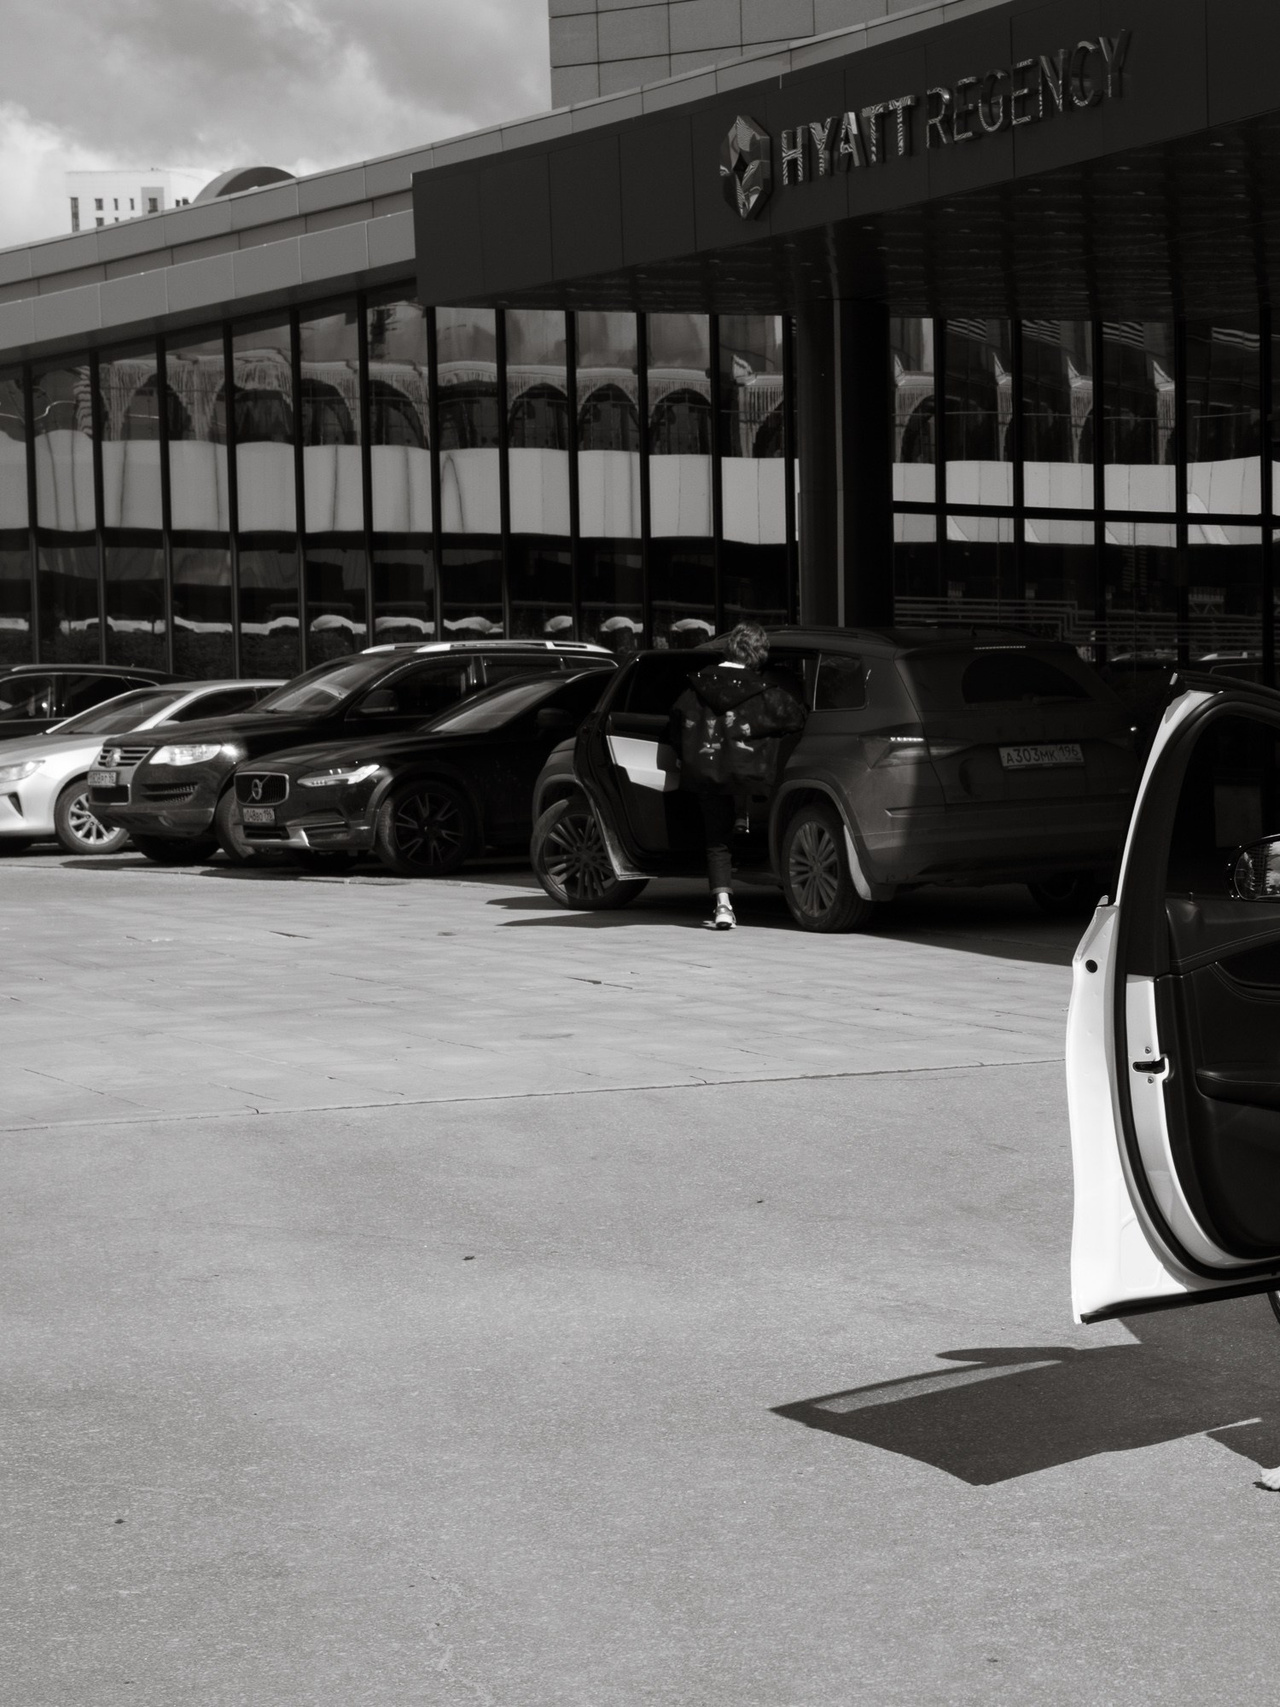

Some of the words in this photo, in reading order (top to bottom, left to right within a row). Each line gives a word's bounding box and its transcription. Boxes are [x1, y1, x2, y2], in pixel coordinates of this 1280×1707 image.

[780, 95, 917, 185] HYATT
[926, 29, 1132, 149] REGENCY
[1059, 745, 1079, 758] 196
